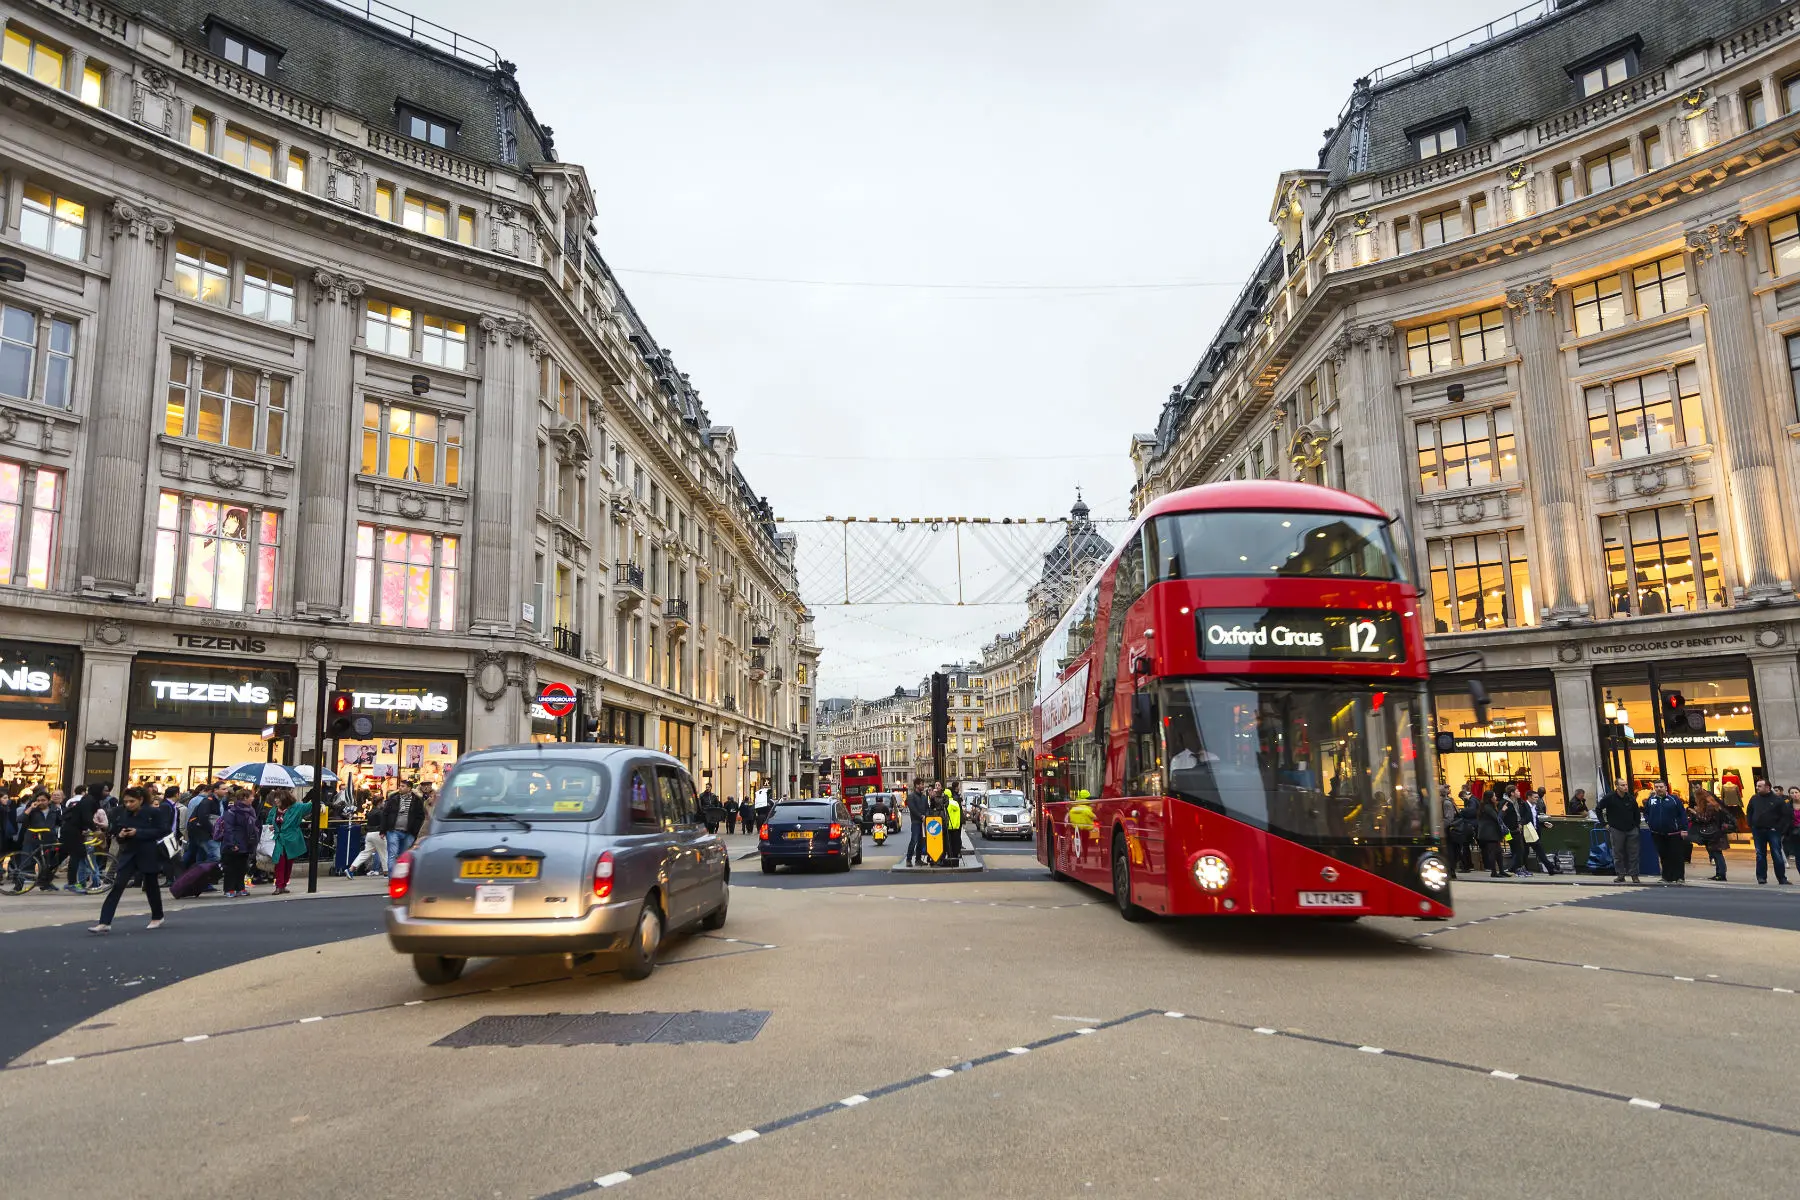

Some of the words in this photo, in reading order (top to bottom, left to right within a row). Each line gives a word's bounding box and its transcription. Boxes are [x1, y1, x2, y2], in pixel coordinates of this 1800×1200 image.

[1207, 624, 1267, 646] Oxford
[1271, 626, 1324, 647] Circus
[1349, 621, 1380, 653] 12
[1591, 644, 1627, 655] UNITED
[1628, 641, 1668, 652] COLORS
[1670, 640, 1685, 649] OF
[1305, 893, 1327, 904] LTZ
